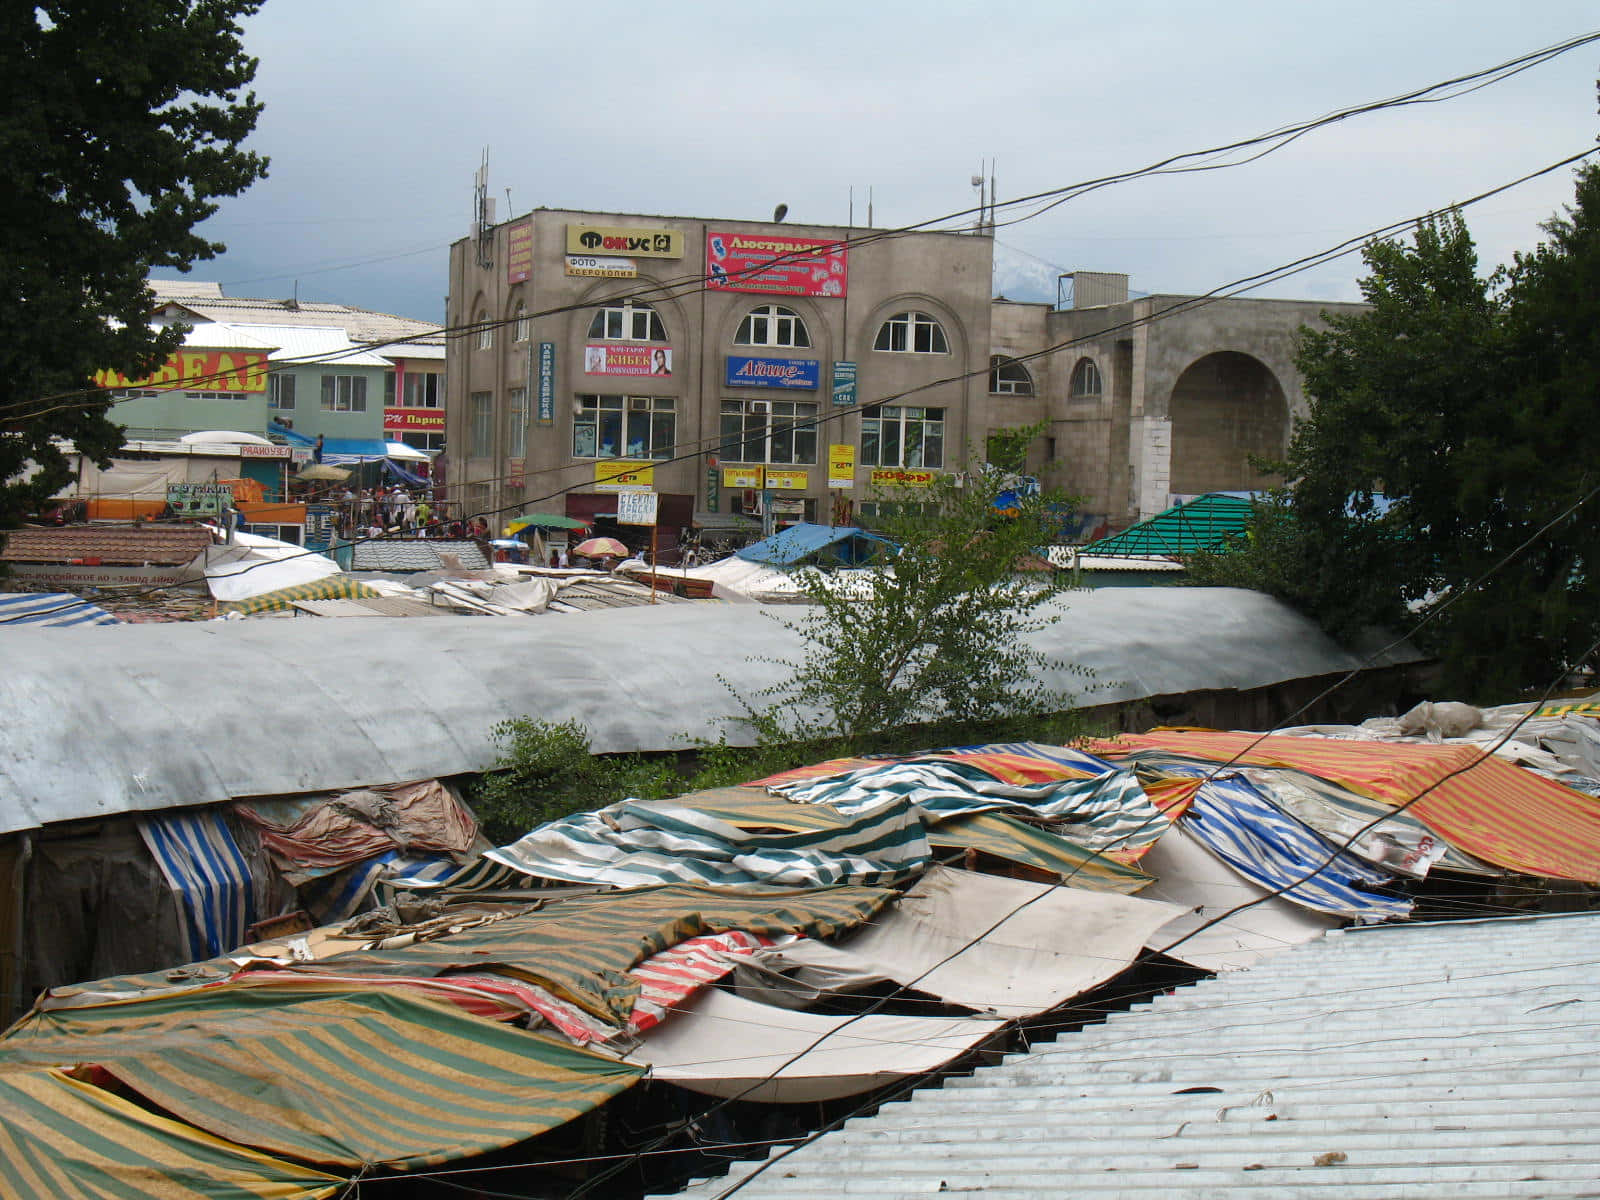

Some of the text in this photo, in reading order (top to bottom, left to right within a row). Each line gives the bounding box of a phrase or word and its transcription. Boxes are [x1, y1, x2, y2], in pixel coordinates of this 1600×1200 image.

[570, 258, 597, 267] ФОТО
[569, 269, 633, 277] КСЕРОКОПИЯ
[607, 355, 650, 365] ЖИБЕК
[242, 446, 292, 456] РАДИОУЗЕЛ
